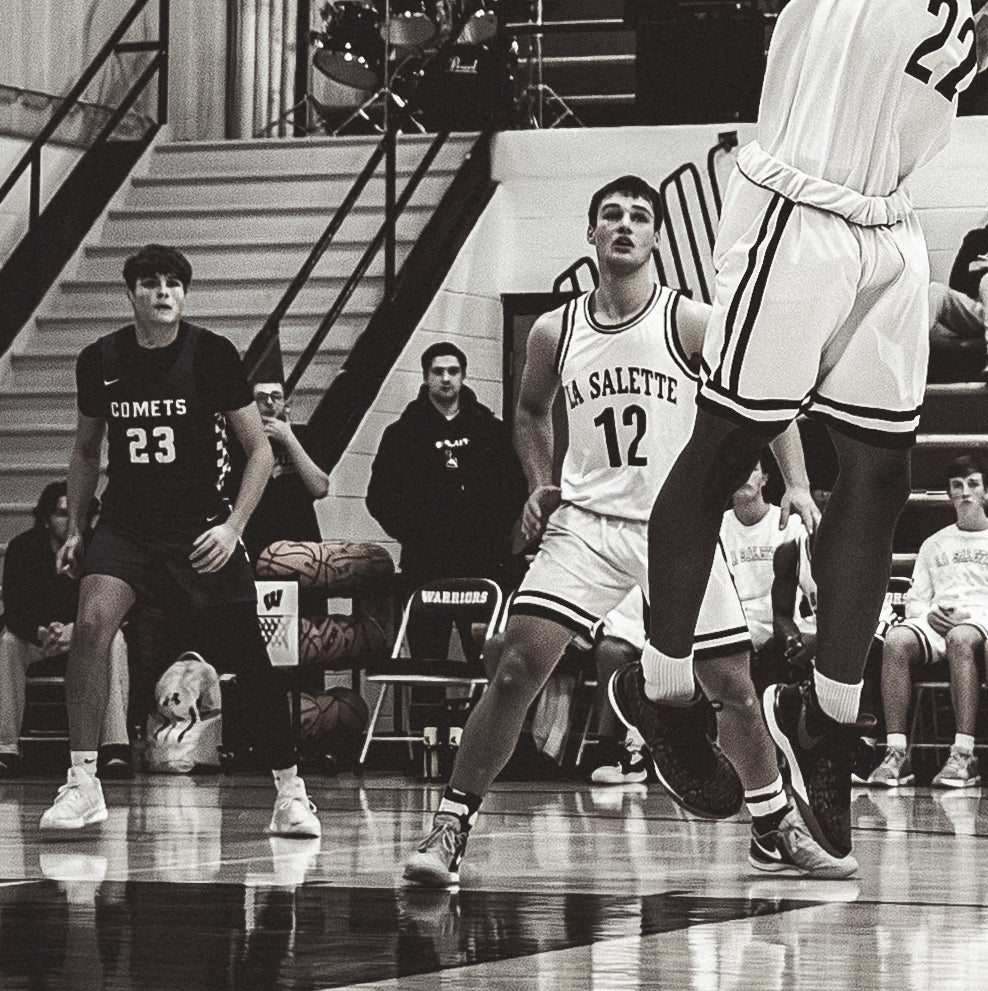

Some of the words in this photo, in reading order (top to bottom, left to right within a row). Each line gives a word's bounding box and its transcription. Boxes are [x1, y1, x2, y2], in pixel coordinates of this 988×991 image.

[565, 379, 585, 410] LA
[589, 366, 679, 405] SALETTE
[110, 398, 187, 418] COMETS
[126, 426, 177, 464] 23
[593, 404, 648, 468] 12
[263, 589, 284, 611] W
[422, 590, 489, 604] WARRIORS
